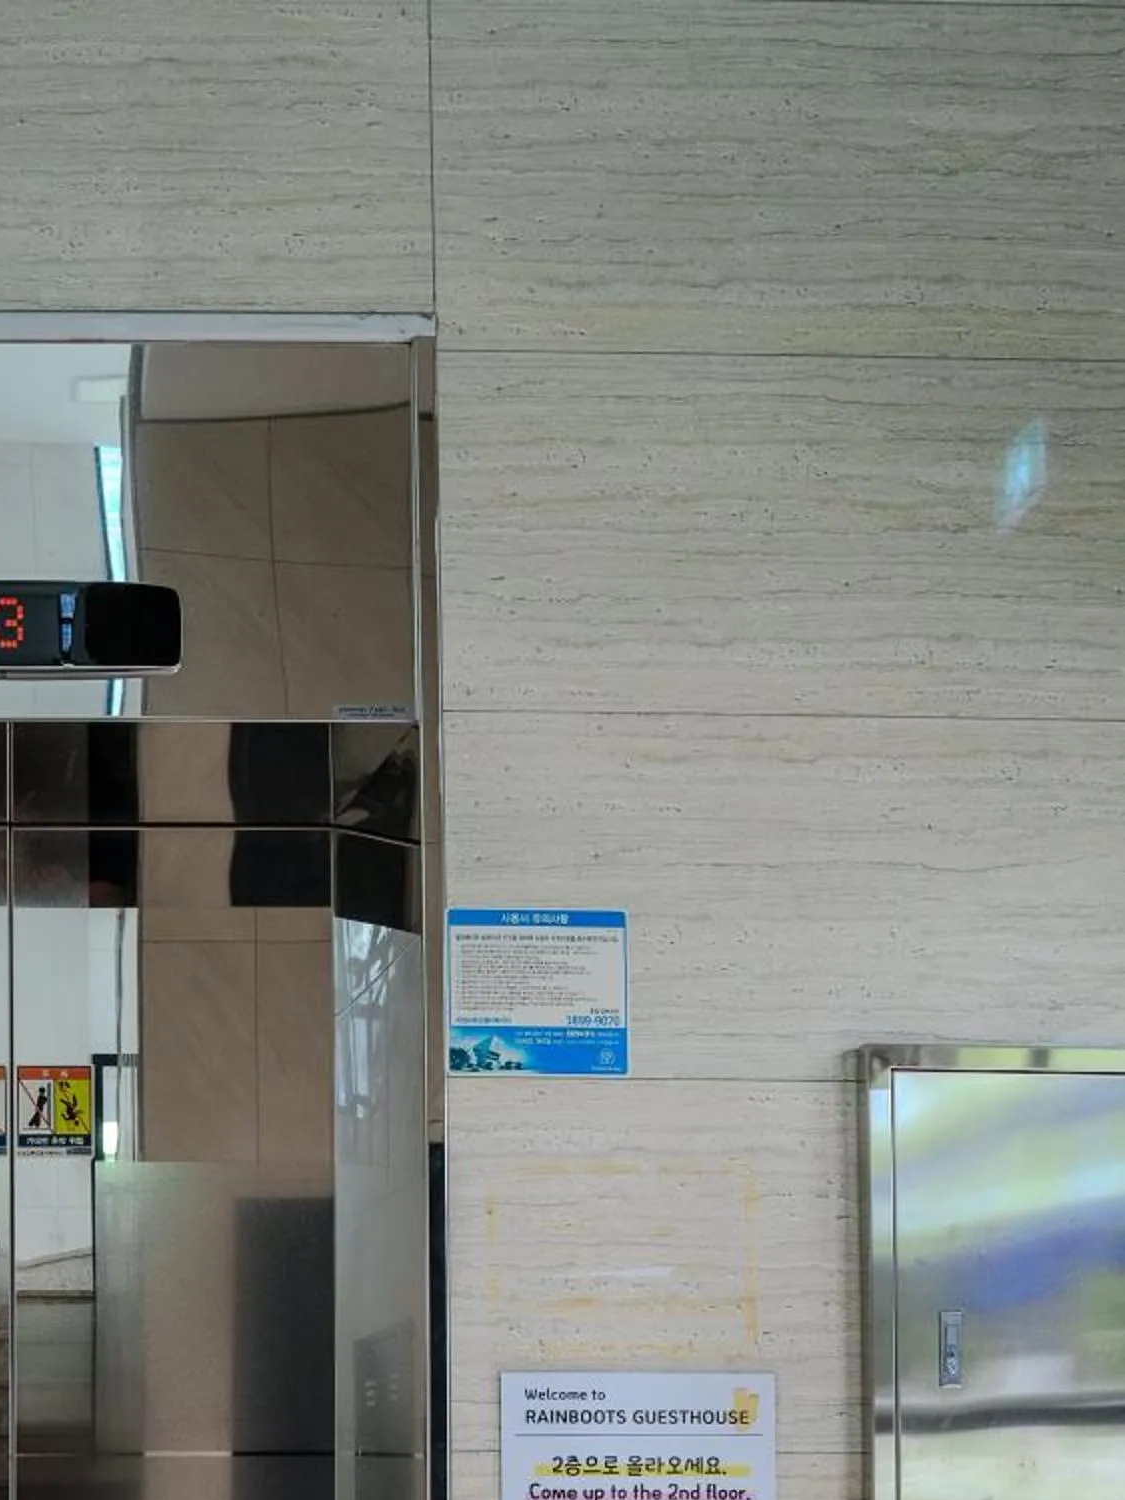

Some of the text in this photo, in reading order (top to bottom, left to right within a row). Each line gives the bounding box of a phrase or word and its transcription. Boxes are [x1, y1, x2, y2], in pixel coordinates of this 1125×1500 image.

[524, 1388, 606, 1401] Welcome to
[525, 1409, 750, 1425] RAINBOOTS GUESTHOUSE
[551, 1455, 620, 1477] 2층으로
[528, 1483, 578, 1500] Come
[611, 1484, 626, 1500] to
[632, 1483, 662, 1500] the
[668, 1483, 701, 1500] 2nd
[706, 1483, 752, 1500] floor.
